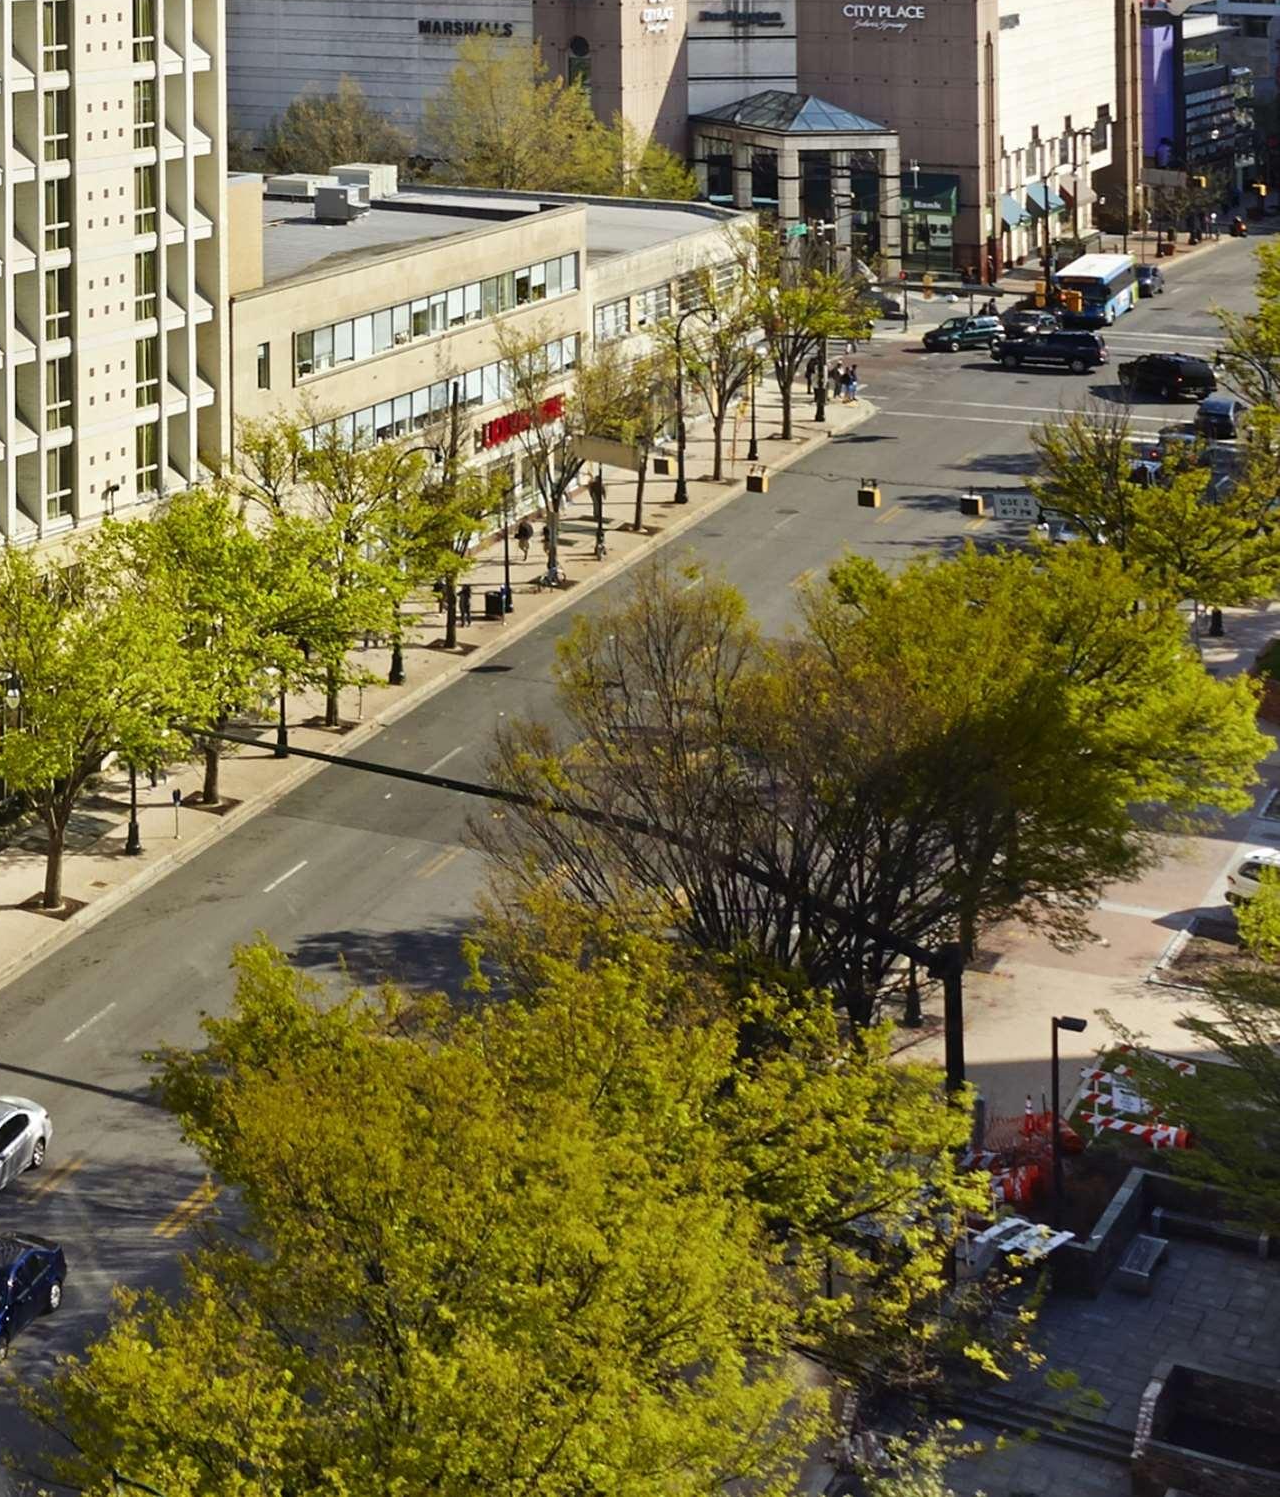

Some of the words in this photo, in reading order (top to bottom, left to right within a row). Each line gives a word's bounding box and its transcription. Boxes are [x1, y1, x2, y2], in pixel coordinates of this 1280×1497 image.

[842, 4, 876, 17] CITY
[878, 5, 926, 19] PLACE
[913, 200, 942, 210] Bank
